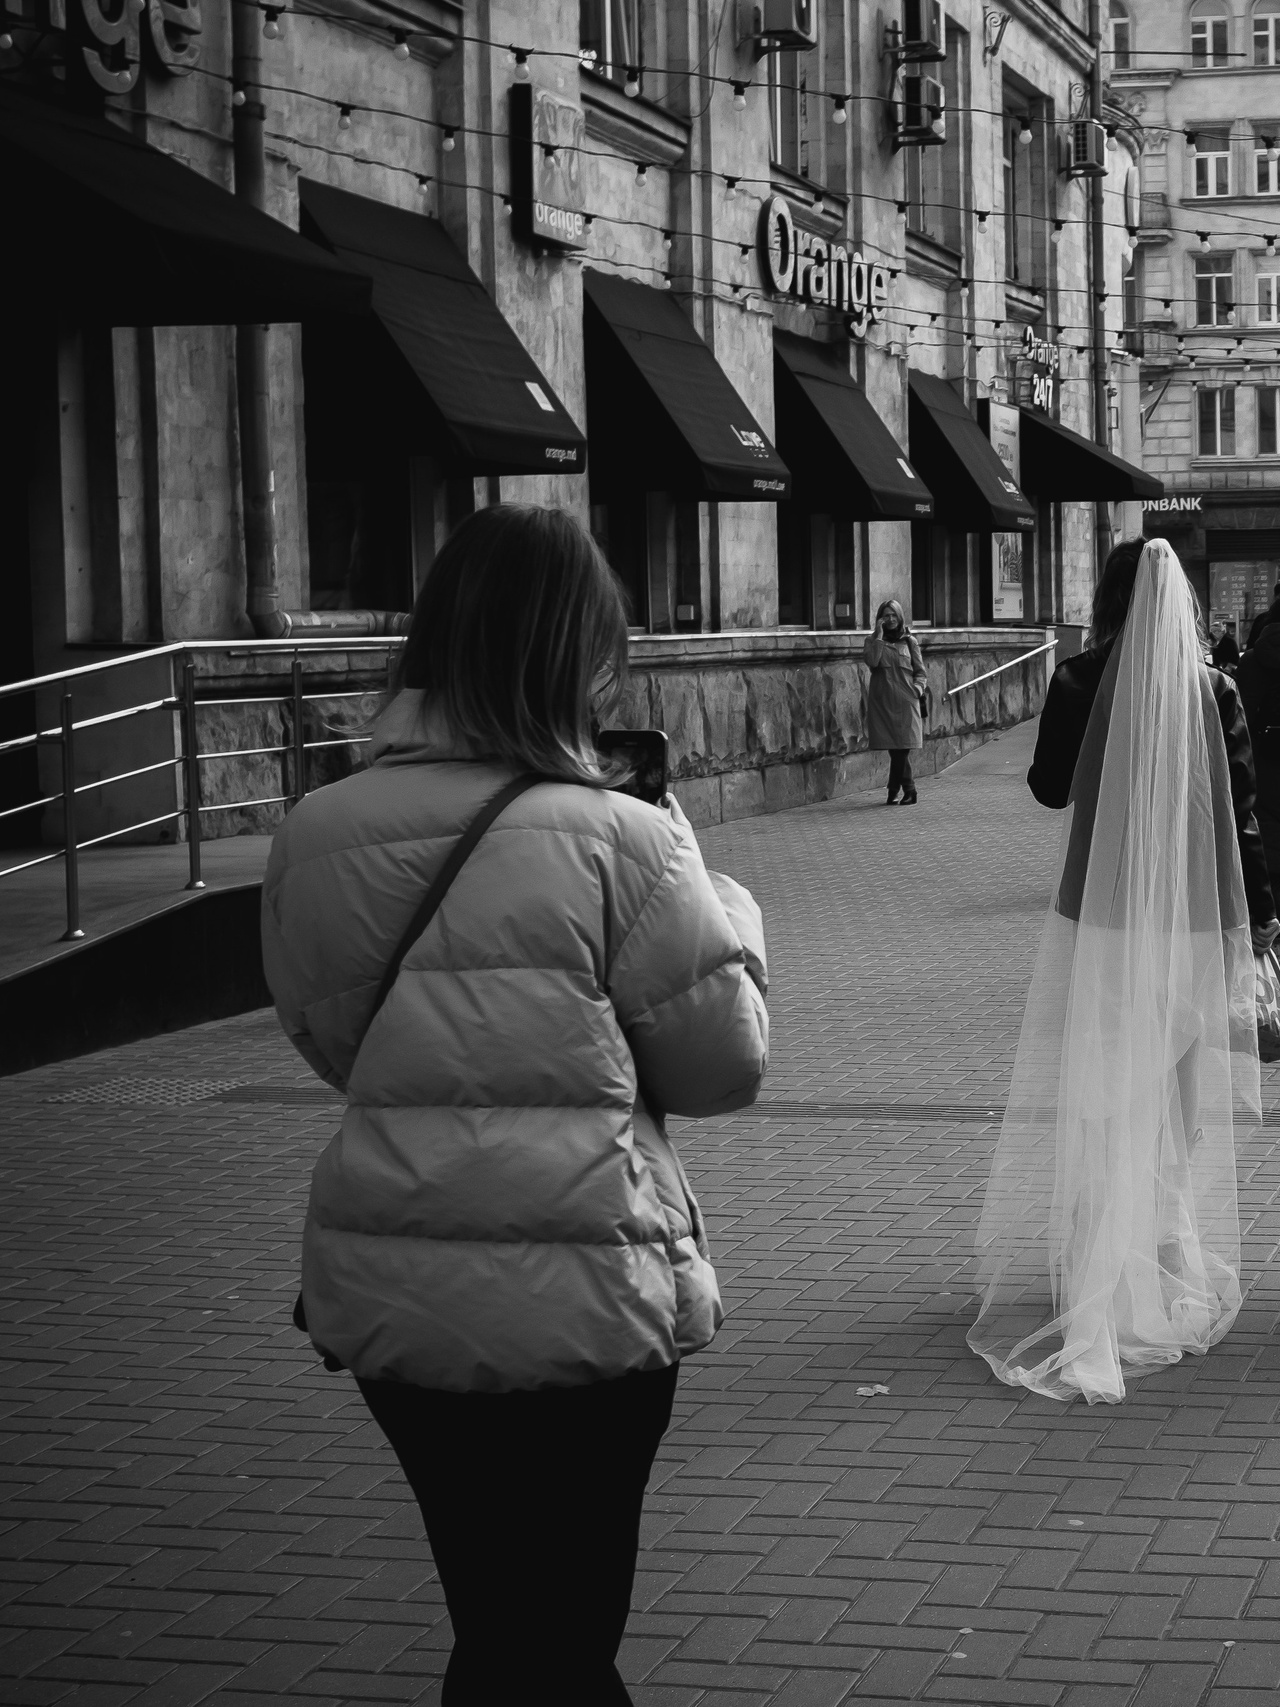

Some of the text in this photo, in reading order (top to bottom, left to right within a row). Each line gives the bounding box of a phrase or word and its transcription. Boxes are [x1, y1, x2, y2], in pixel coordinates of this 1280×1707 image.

[535, 201, 583, 240] orange
[764, 196, 888, 338] Orange
[1025, 325, 1059, 375] Orange
[1033, 373, 1054, 411] 24/7
[545, 447, 577, 462] orange.md
